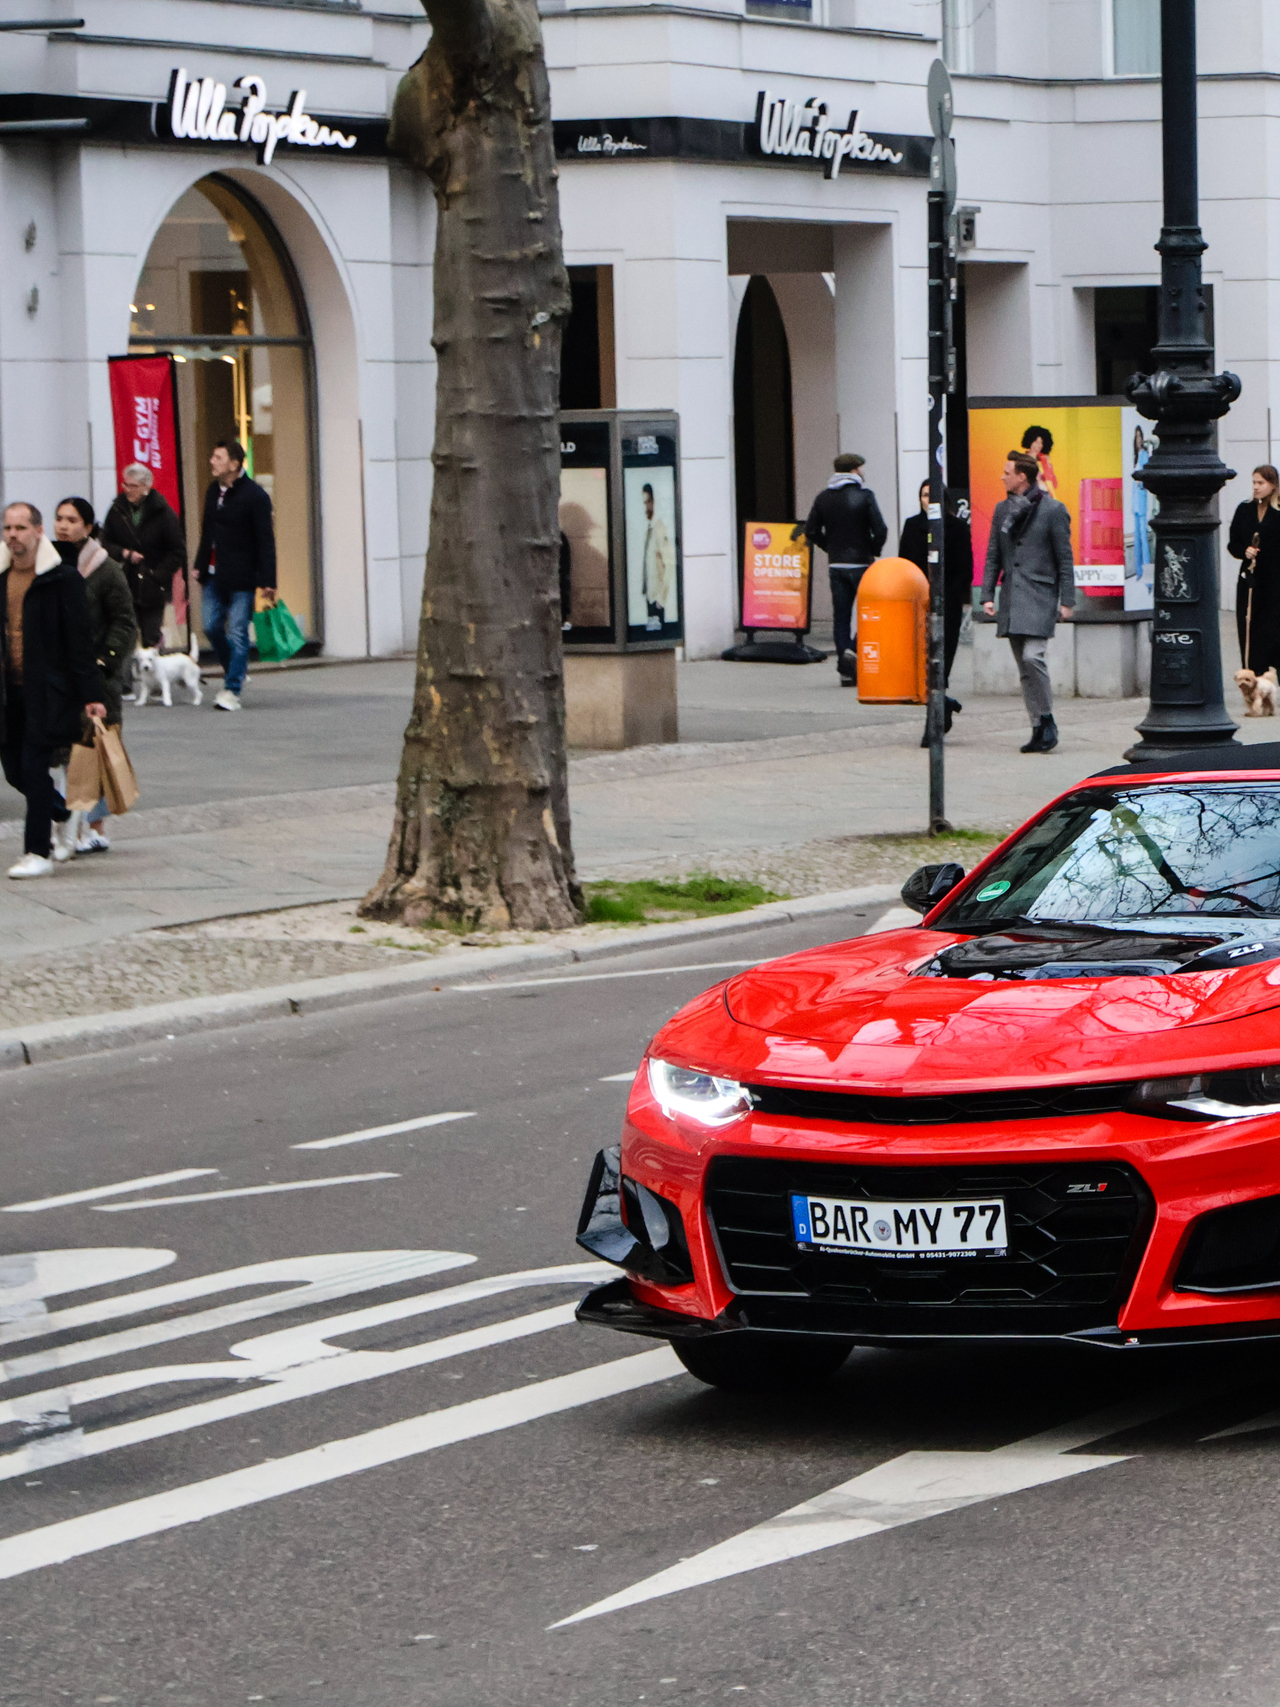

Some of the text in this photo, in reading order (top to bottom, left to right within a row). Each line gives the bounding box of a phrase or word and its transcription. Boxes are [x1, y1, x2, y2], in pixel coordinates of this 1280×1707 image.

[169, 68, 358, 165] Ulla Popken
[757, 90, 904, 179] Ulla Popken
[753, 567, 802, 578] OPENING
[754, 554, 802, 568] STORE
[1066, 1183, 1108, 1194] ZL1
[809, 1202, 872, 1243] BAR
[893, 1207, 942, 1245] MY
[953, 1204, 1002, 1243] 77
